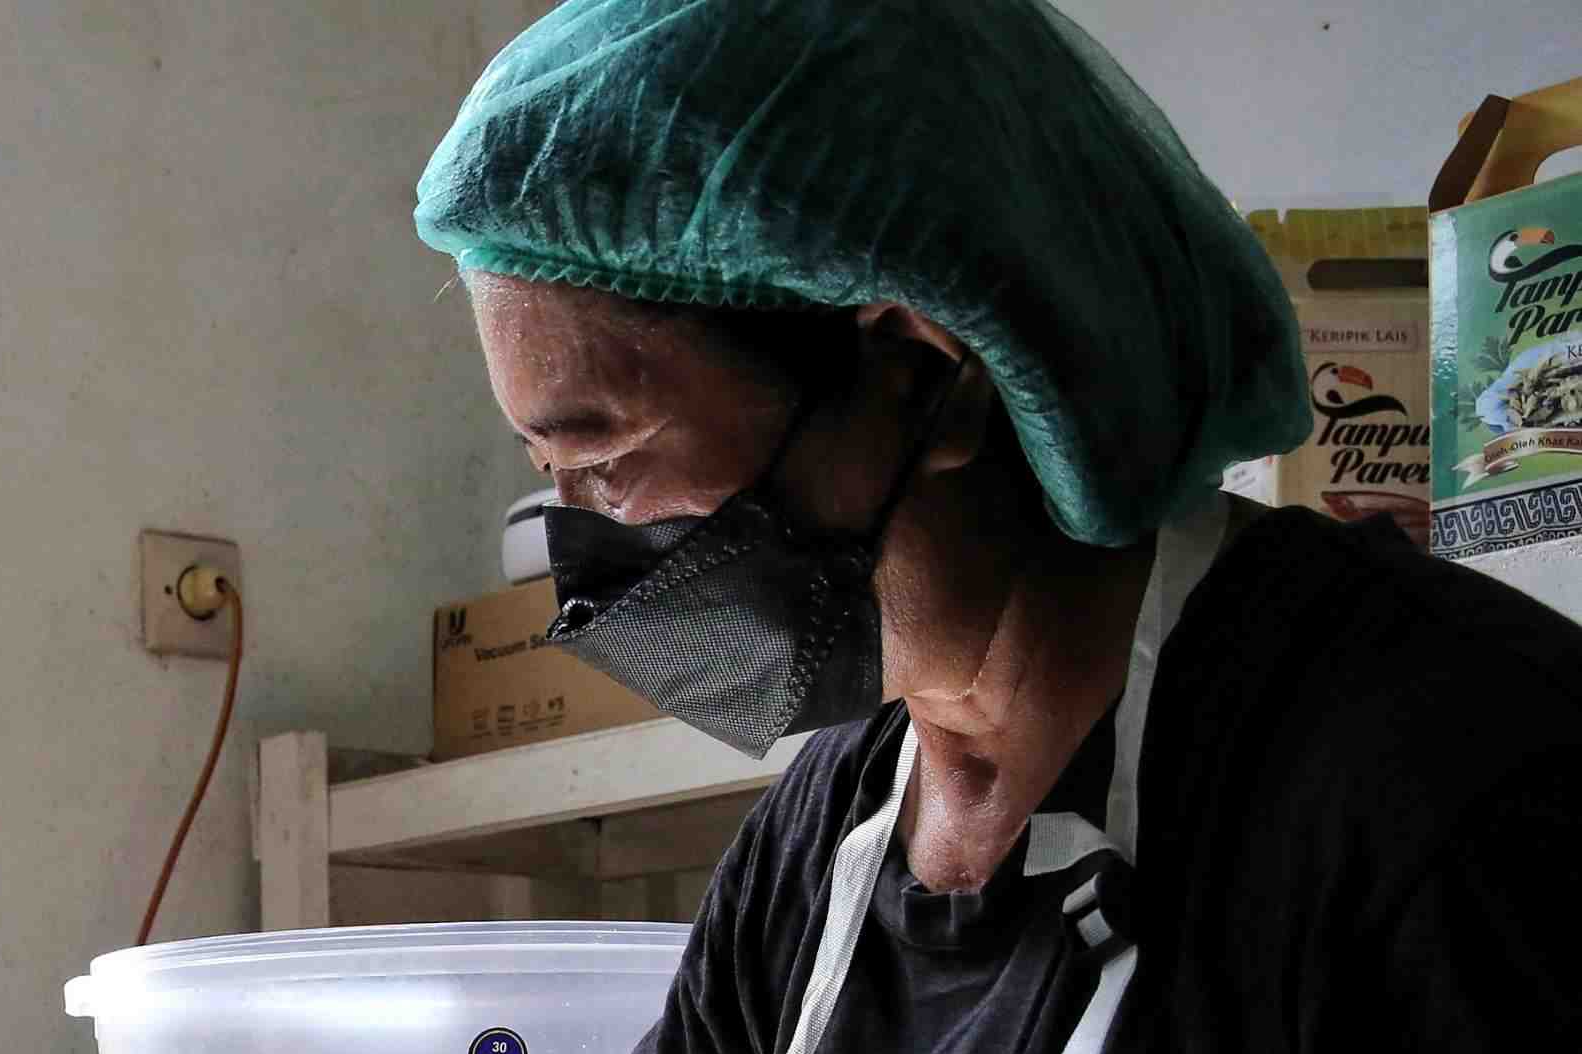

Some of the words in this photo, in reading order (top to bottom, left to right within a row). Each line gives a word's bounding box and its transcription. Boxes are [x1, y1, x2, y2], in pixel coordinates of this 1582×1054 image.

[1309, 328, 1370, 343] KERIPIK
[1375, 329, 1409, 343] LAIS
[491, 1041, 508, 1054] 30
